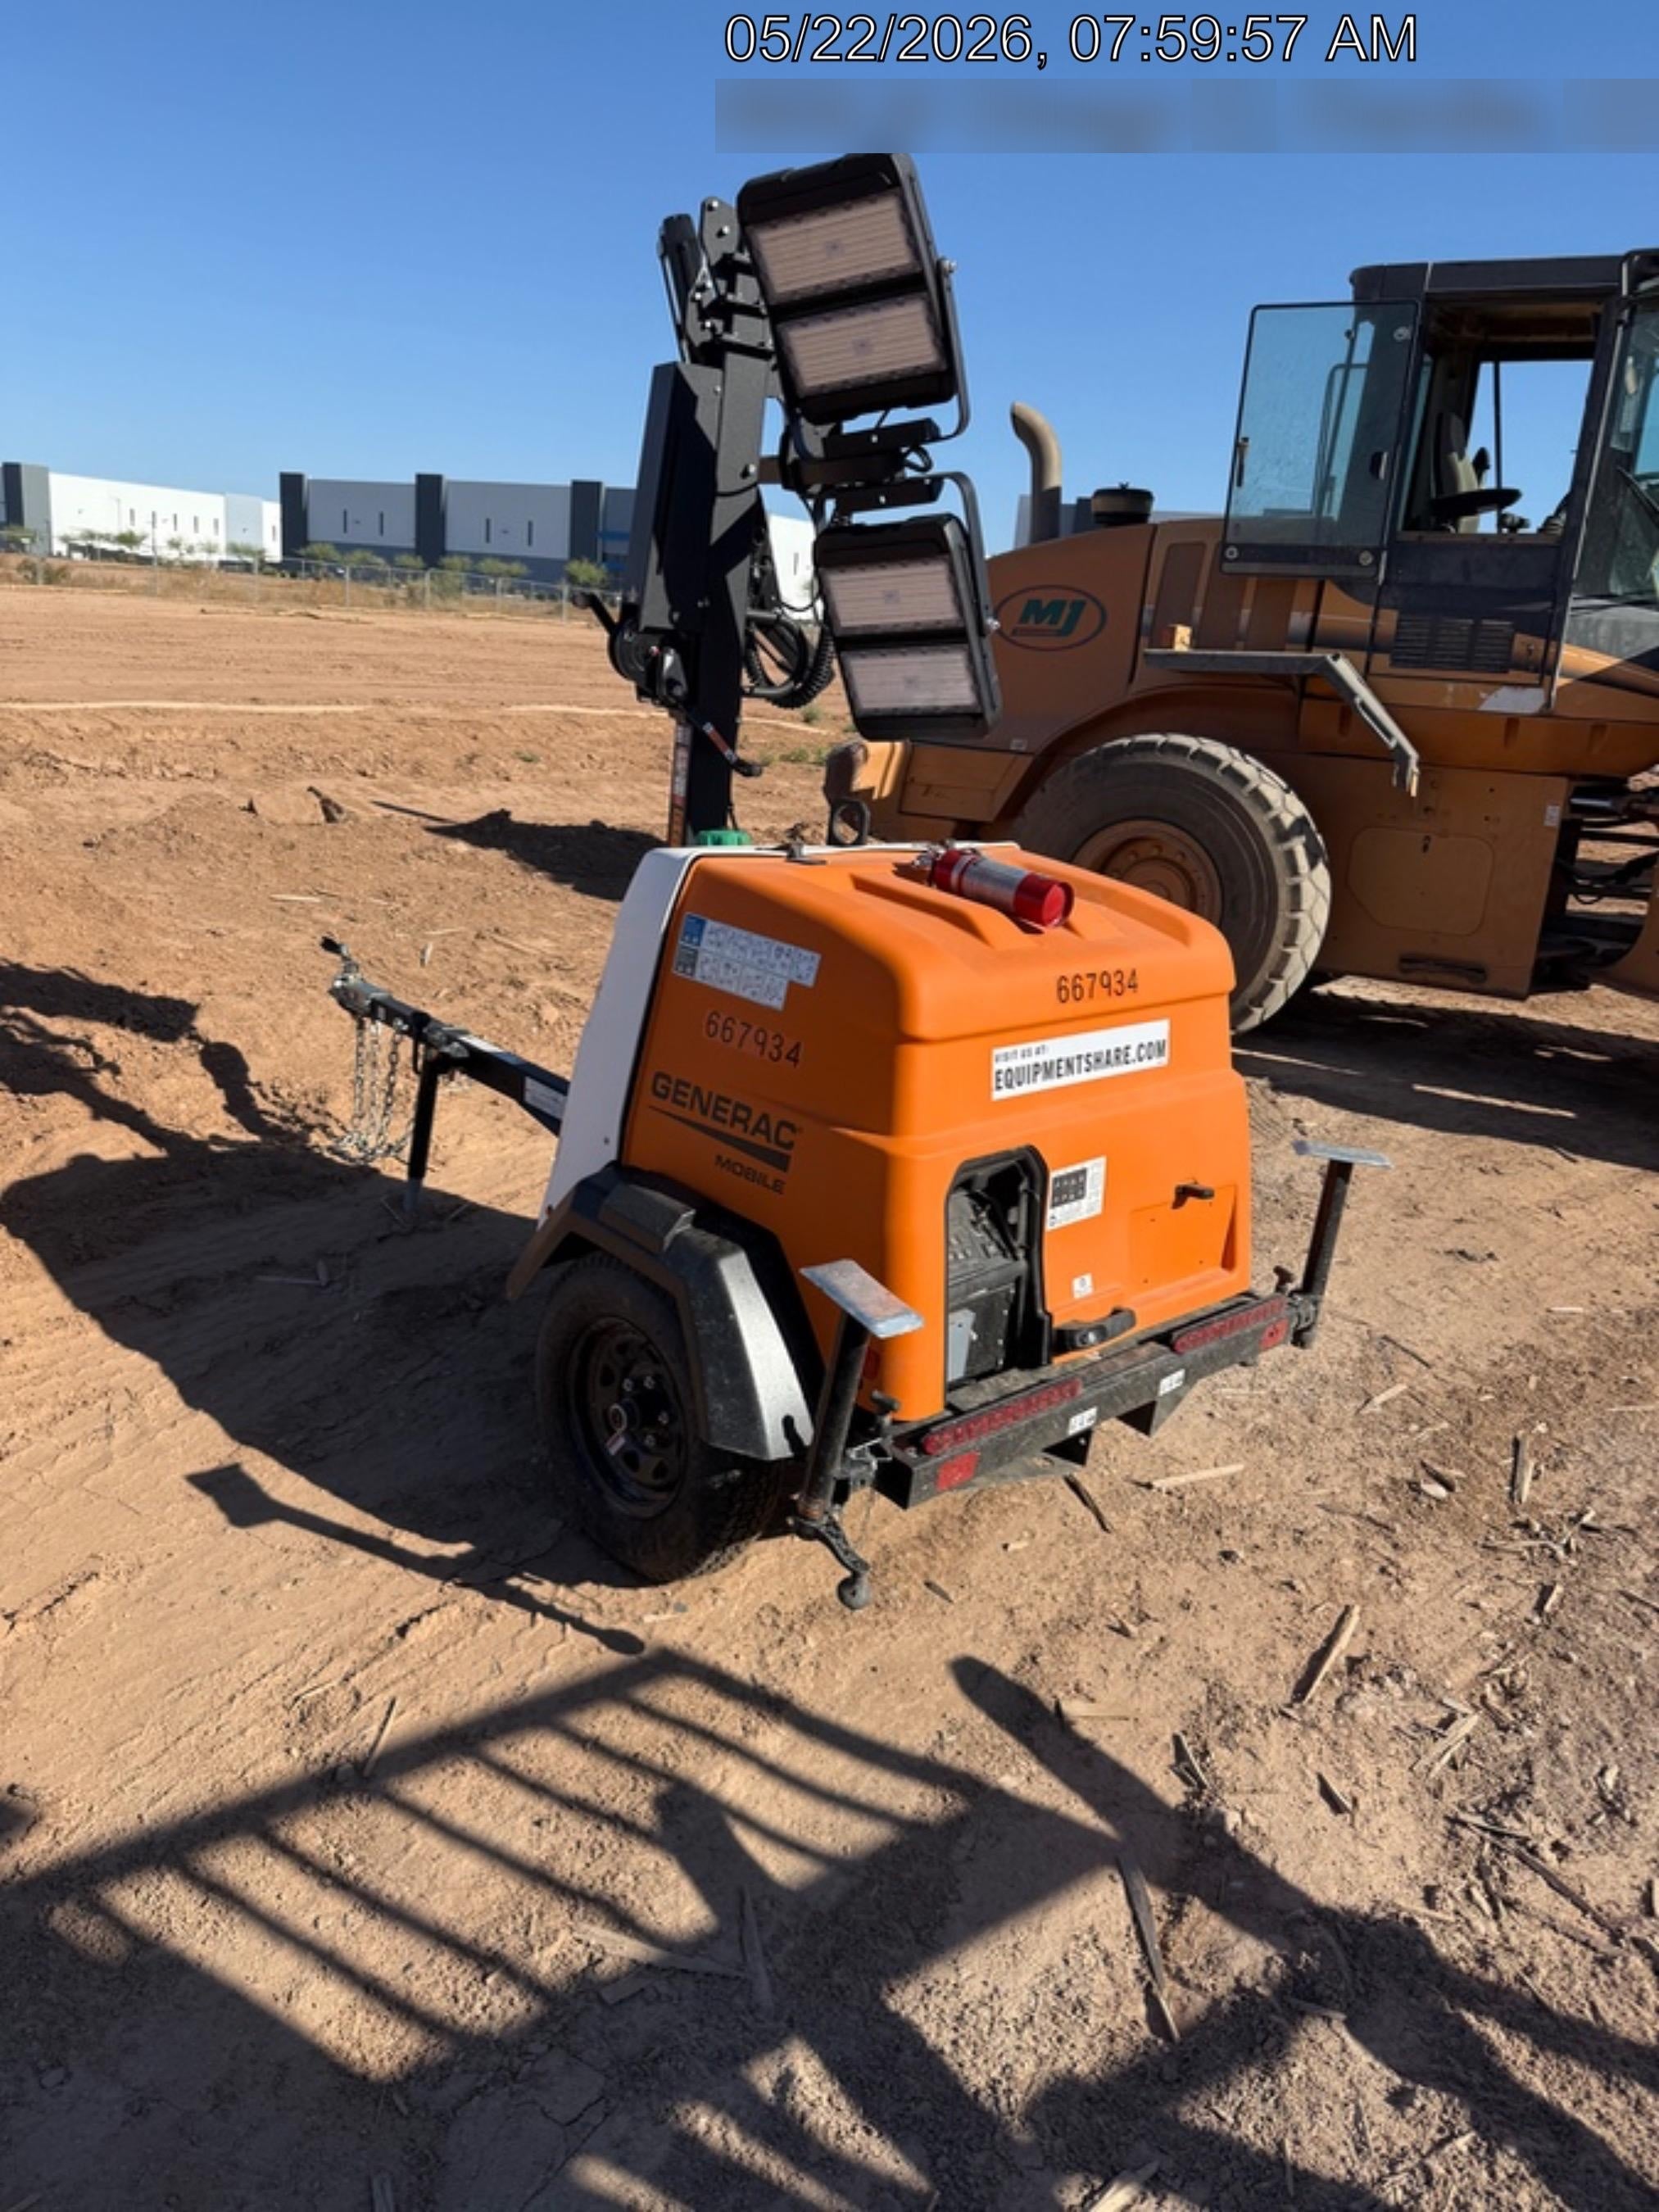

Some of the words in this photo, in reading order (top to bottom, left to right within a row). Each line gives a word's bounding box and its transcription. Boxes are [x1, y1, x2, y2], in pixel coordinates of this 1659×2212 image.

[1020, 599, 1086, 637] MJ
[1057, 968, 1138, 1004] 667934
[705, 1010, 802, 1068] 667934
[995, 1039, 1167, 1092] EQUIPMENTSHARE.COM
[650, 1071, 797, 1151] GENERAC
[714, 1154, 786, 1194] MOBILE
